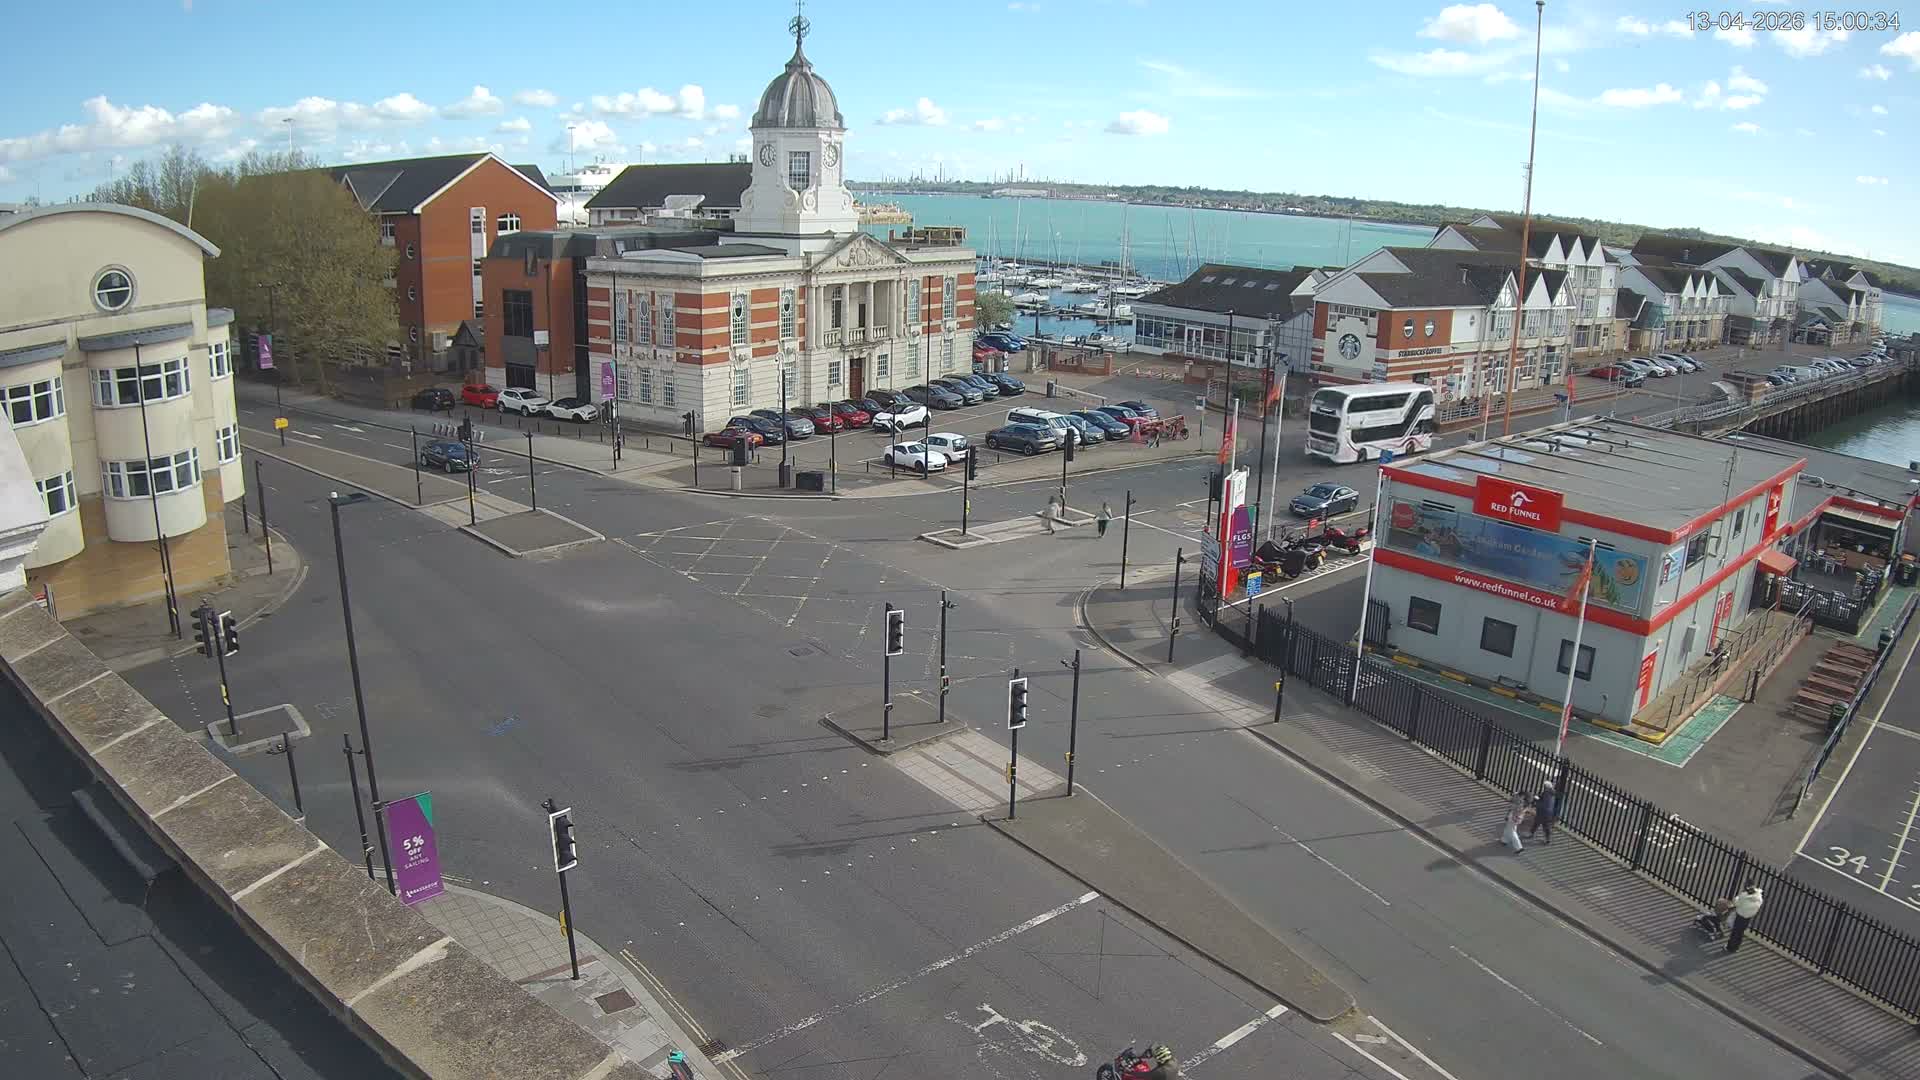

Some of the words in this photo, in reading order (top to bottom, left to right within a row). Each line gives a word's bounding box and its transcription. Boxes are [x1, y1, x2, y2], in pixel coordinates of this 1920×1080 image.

[1491, 502, 1507, 513] RED
[1510, 506, 1541, 521] FUNNEL
[1455, 574, 1557, 608] www.redfunnel.co.uk
[403, 835, 424, 851] 5%
[408, 847, 422, 856] OFF
[1823, 846, 1871, 874] 34
